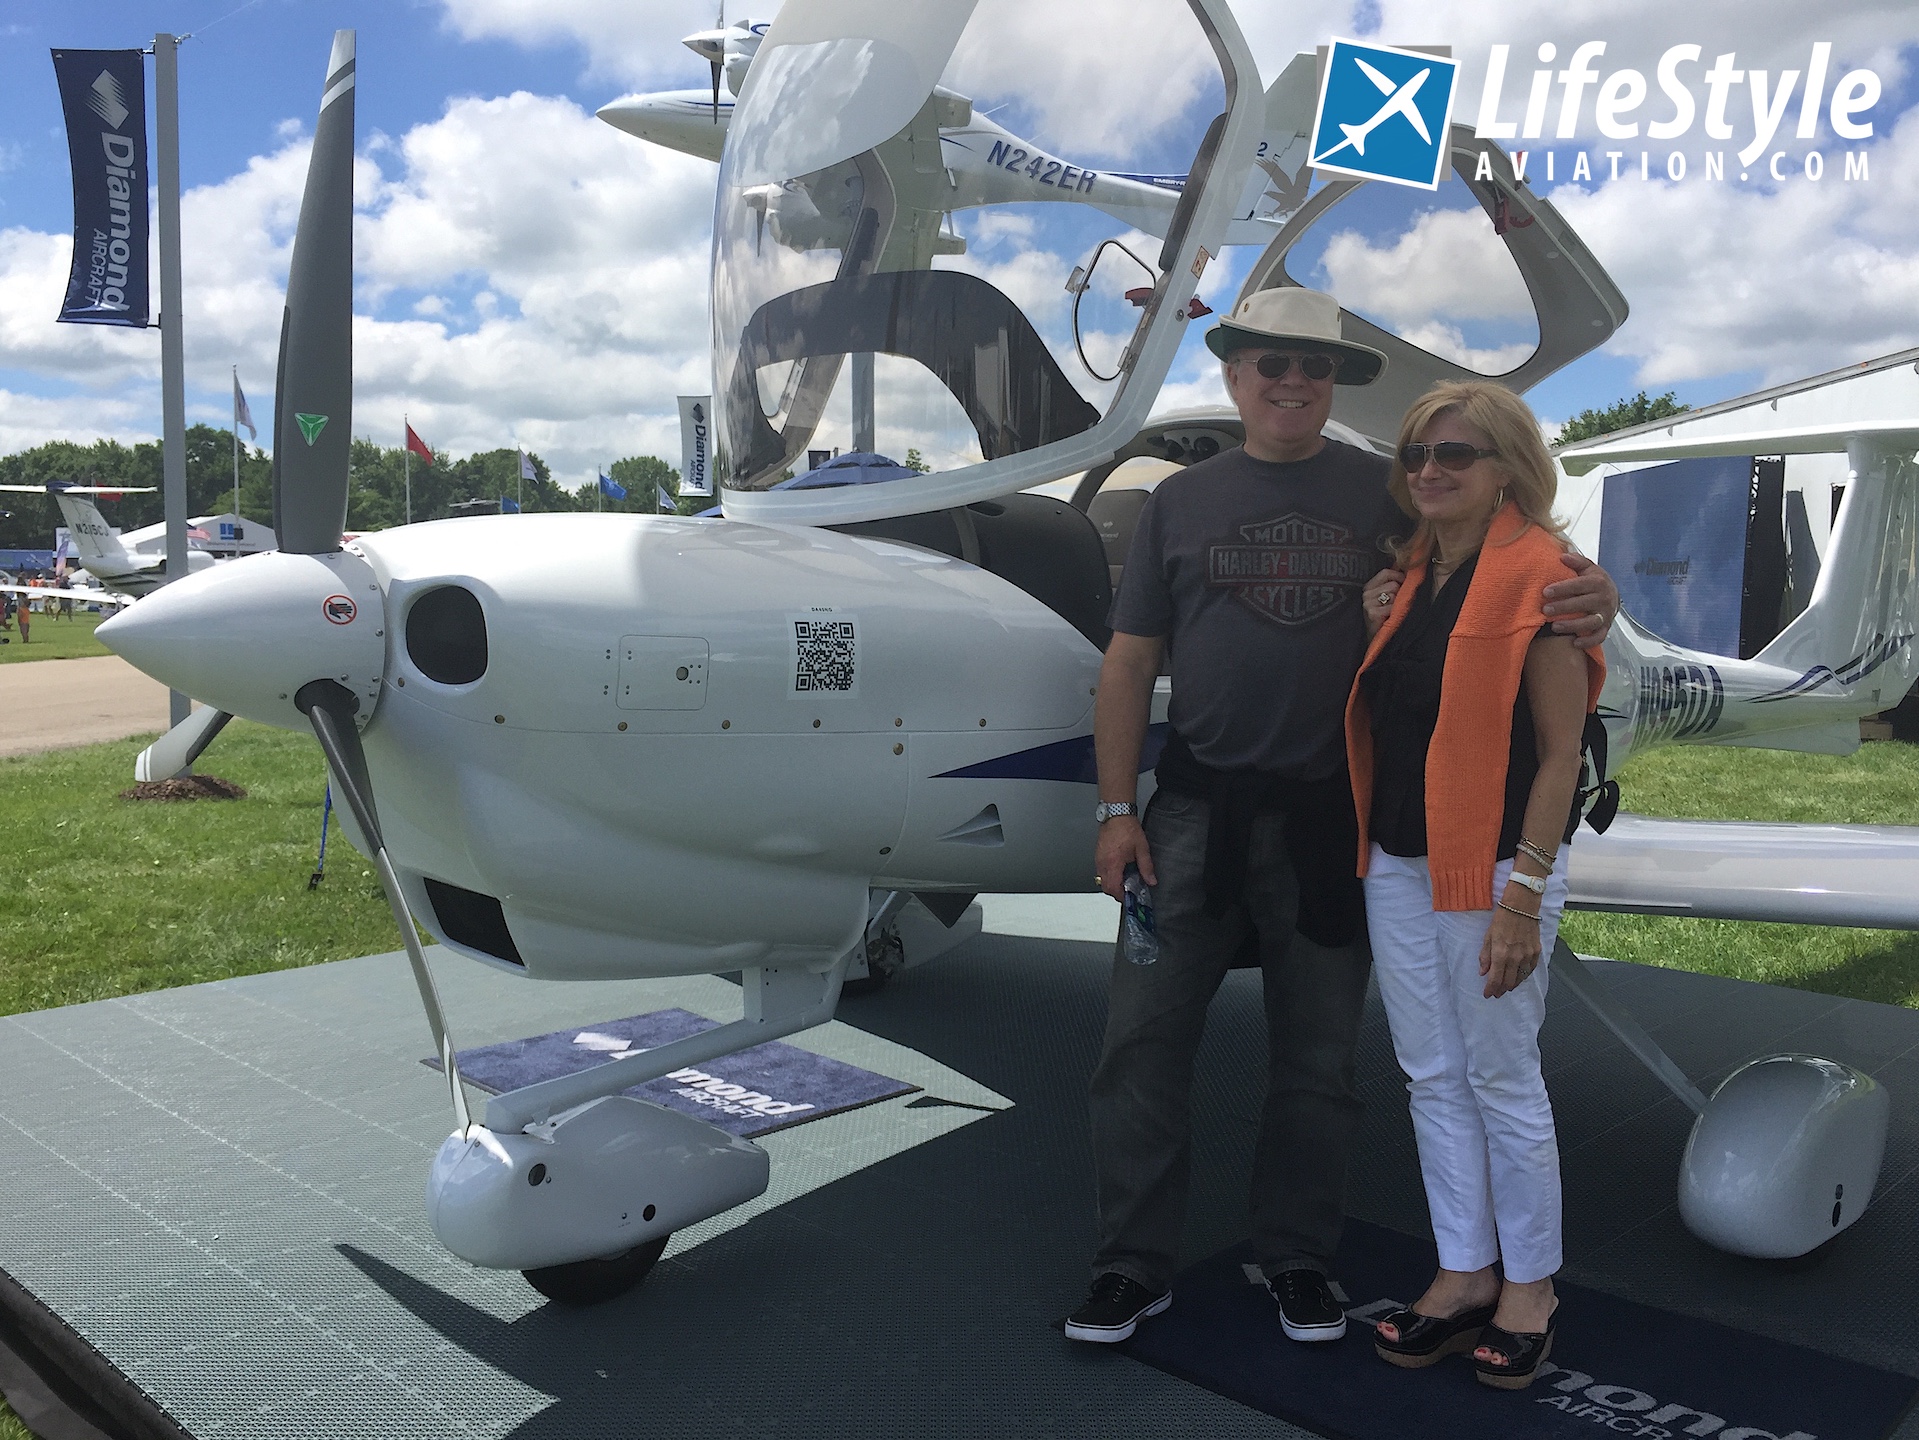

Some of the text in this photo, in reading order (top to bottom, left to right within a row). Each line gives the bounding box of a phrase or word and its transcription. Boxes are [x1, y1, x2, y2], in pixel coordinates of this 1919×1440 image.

[986, 140, 1098, 195] N242ER
[101, 131, 137, 312] Diamond
[85, 227, 108, 306] AIRCRAFT
[695, 424, 707, 490] Diamond
[1254, 518, 1336, 544] MOTOR
[1217, 551, 1370, 579] HARLEY-DAVIDSON
[1252, 585, 1335, 618] CYCLES
[670, 1087, 765, 1119] AIRCRAFT
